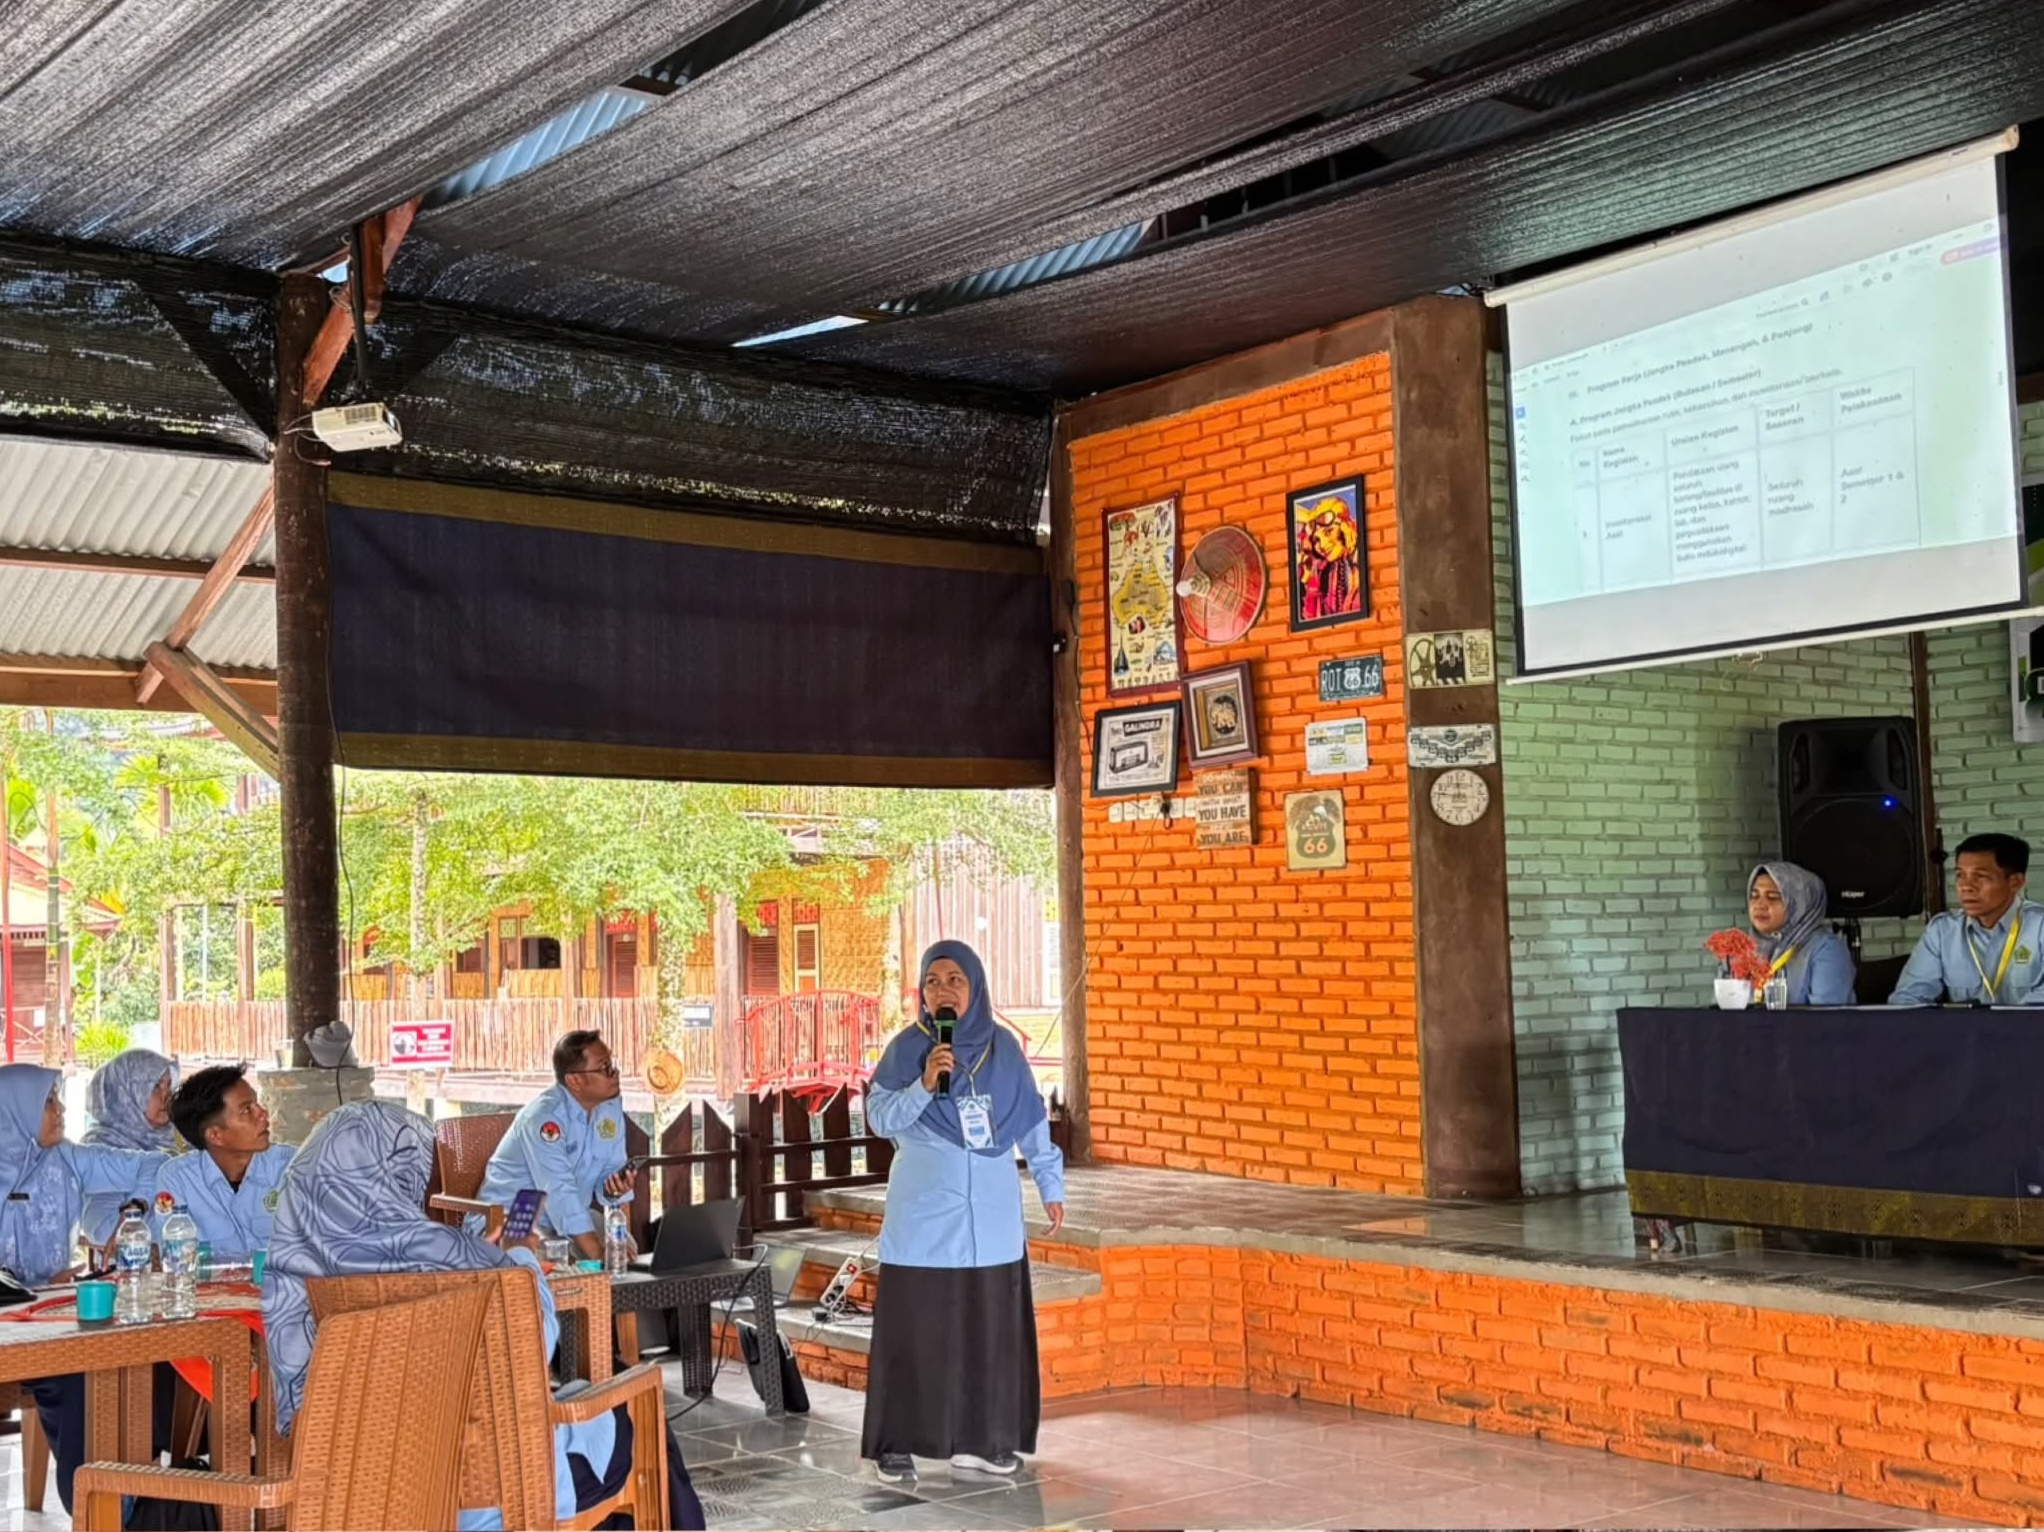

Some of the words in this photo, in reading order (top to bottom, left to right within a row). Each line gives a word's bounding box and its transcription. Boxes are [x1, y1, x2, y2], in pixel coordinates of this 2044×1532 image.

[1198, 808, 1218, 821] YOU
[1220, 805, 1246, 818] HAVE
[1200, 833, 1221, 844] YOU
[1304, 837, 1327, 854] 66
